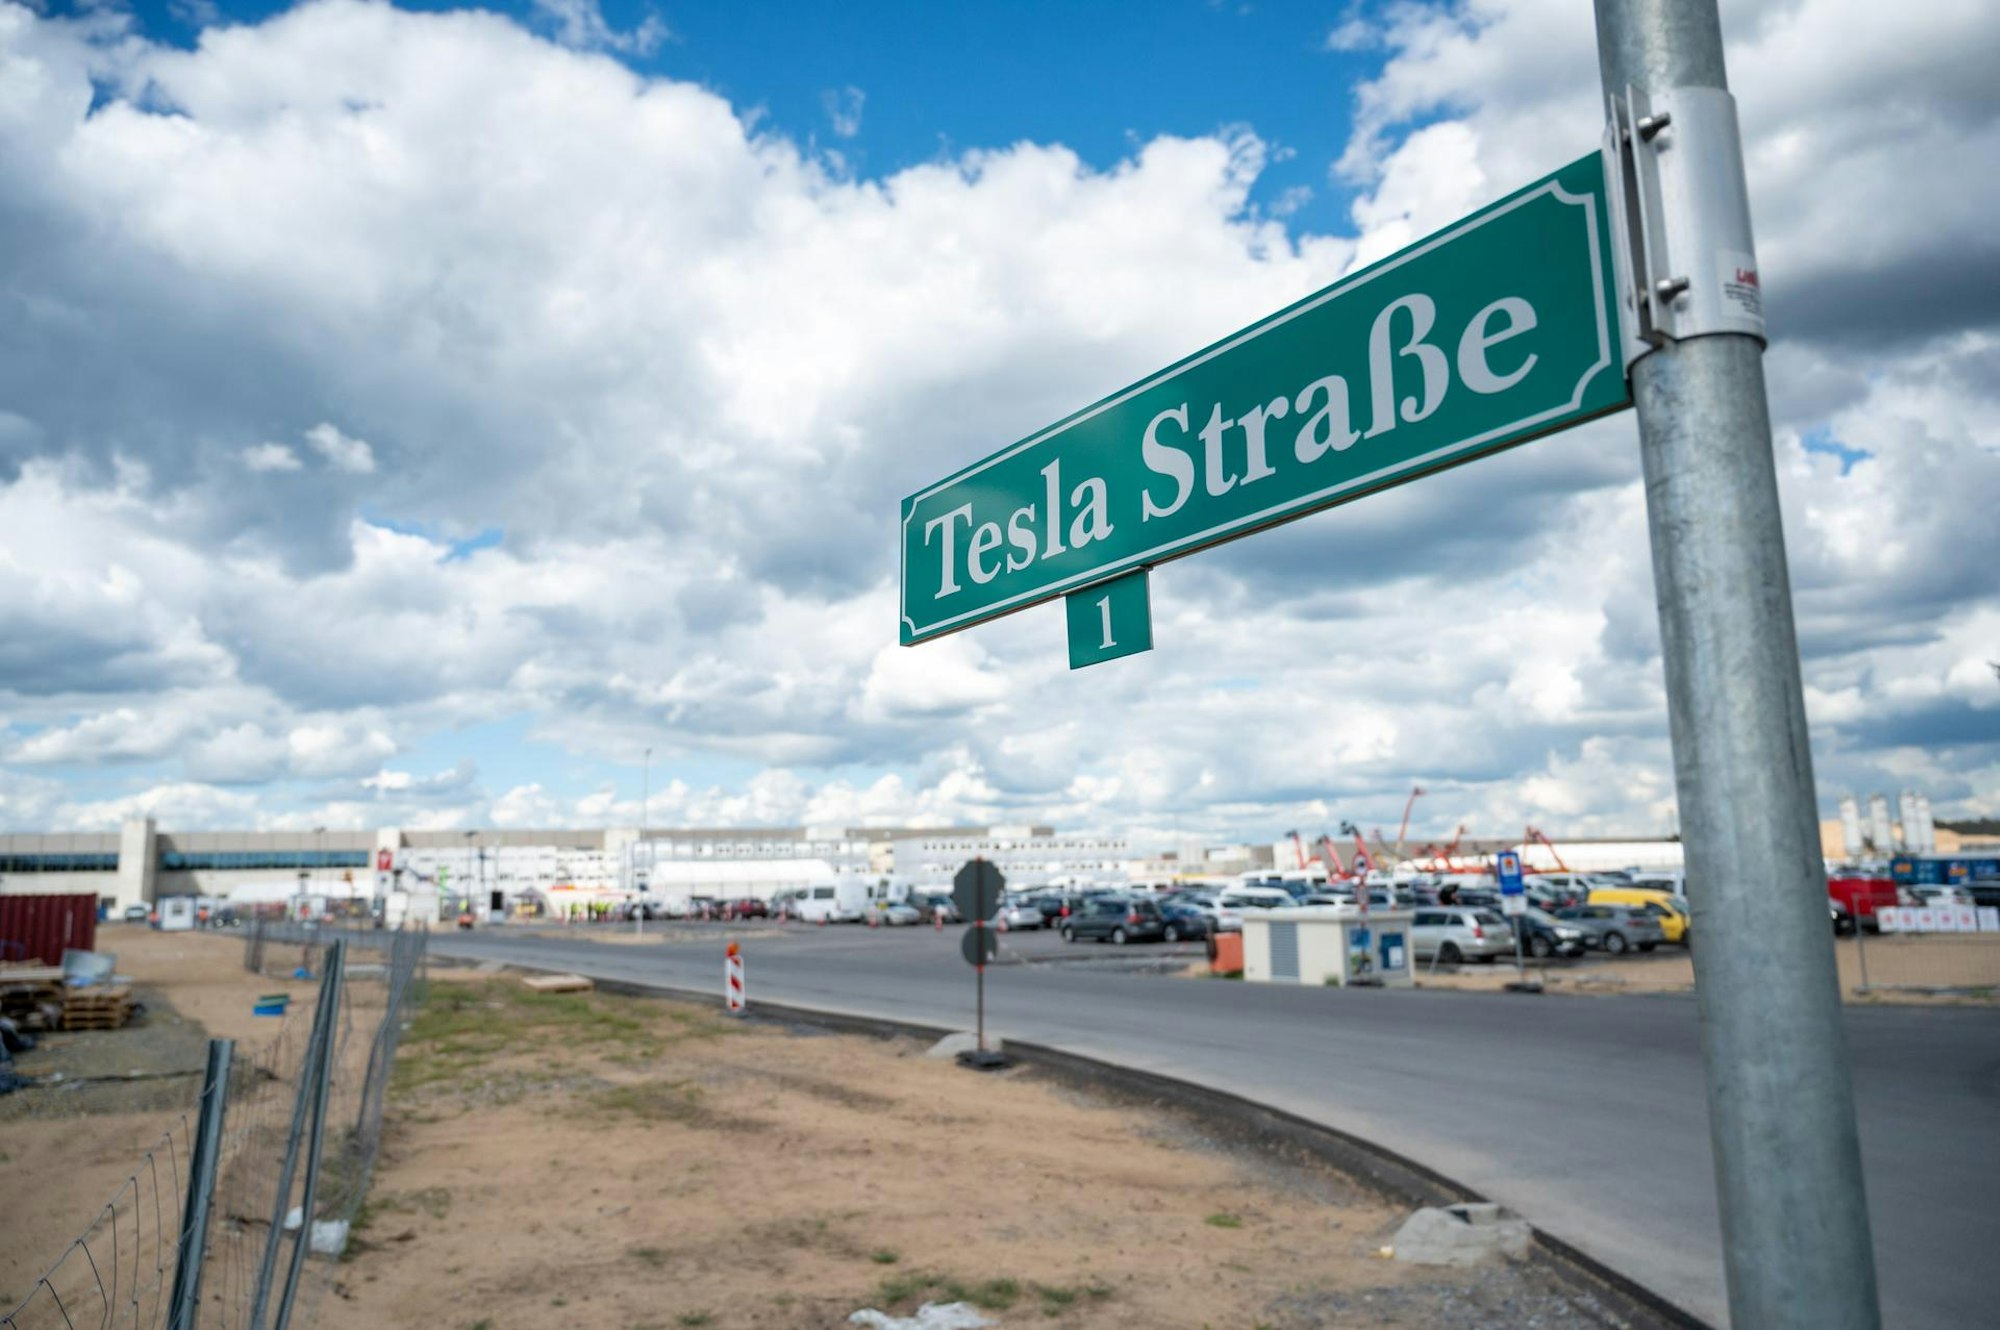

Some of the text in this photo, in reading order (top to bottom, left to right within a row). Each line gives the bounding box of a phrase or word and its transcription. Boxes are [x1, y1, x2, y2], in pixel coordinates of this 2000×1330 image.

[925, 293, 1538, 600] Tesla Straße
[1097, 595, 1117, 649] 1
